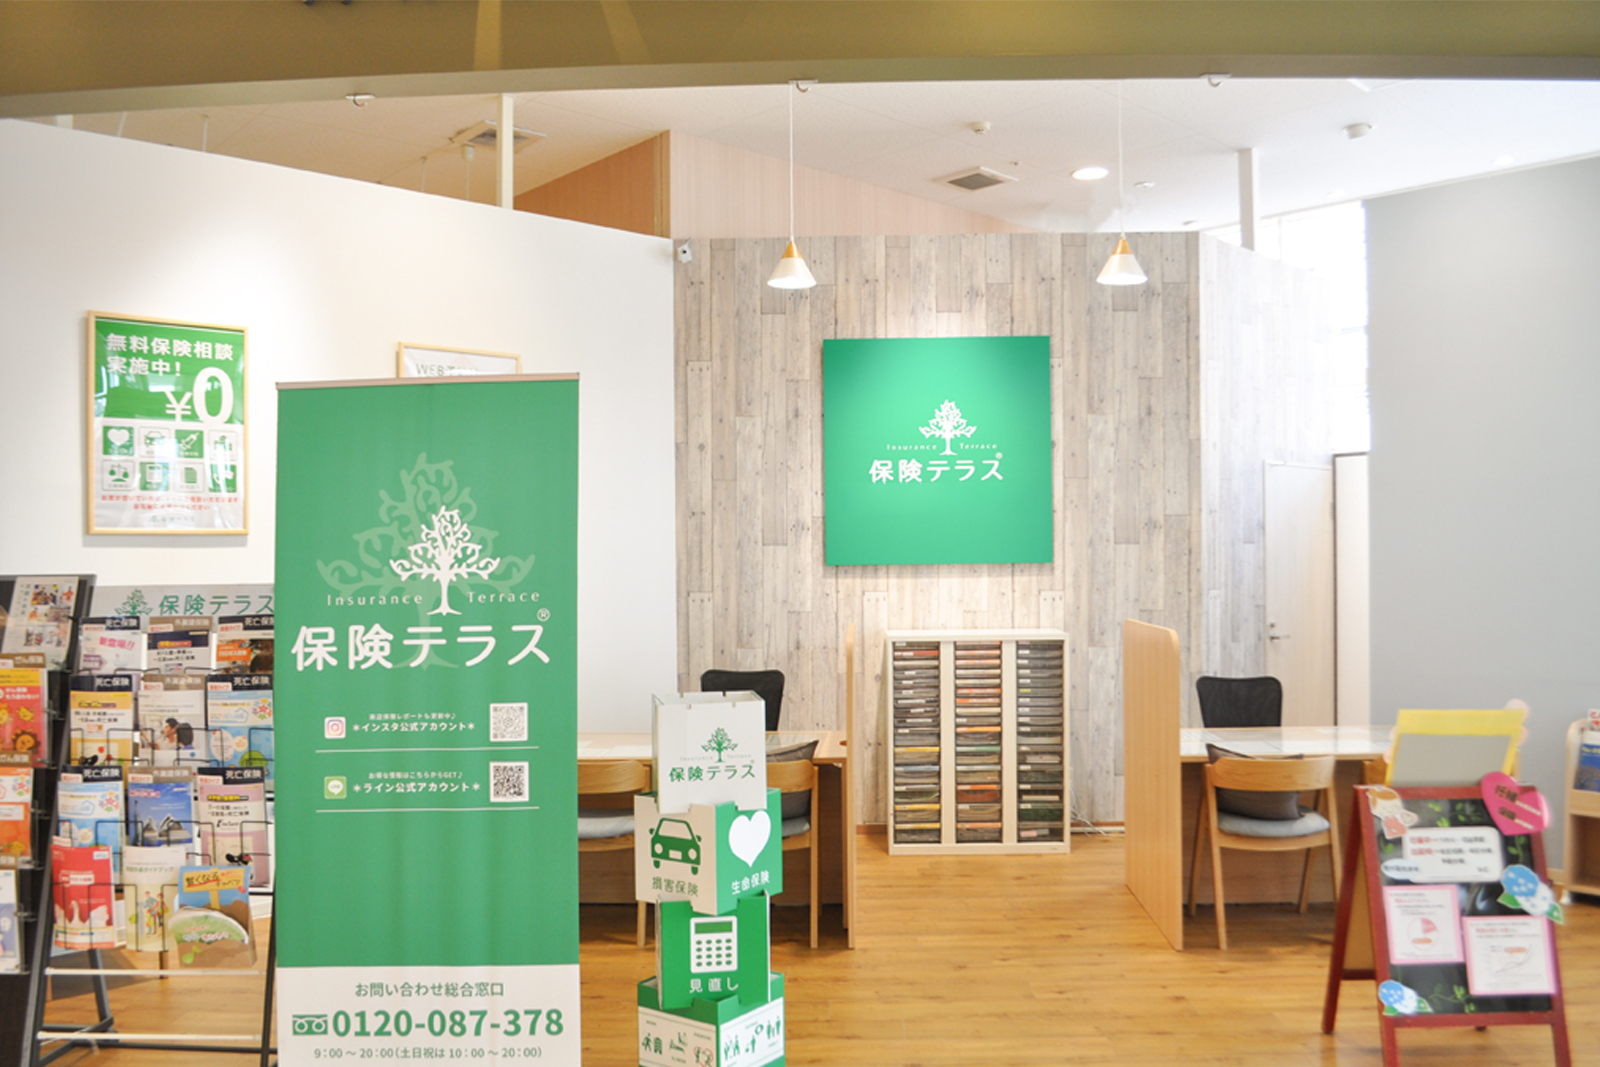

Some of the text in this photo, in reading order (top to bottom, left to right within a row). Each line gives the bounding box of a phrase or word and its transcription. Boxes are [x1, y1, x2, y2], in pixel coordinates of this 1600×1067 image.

[106, 333, 233, 360] 無料保険相談
[106, 355, 181, 376] 実施中!
[886, 442, 998, 451] Insurance Terrace
[869, 458, 1003, 484] 保険テラス
[159, 594, 274, 616] 保険テラス
[327, 591, 540, 606] Insurance Terrace
[291, 623, 550, 672] 保険テラス
[669, 764, 756, 782] 保険テラス
[652, 876, 699, 897] 損害保険
[731, 869, 770, 895] 生命保険
[355, 981, 505, 998] お問い合わせ総合窓口
[689, 977, 739, 994] 見直し
[332, 1008, 564, 1038] 0120-087-378
